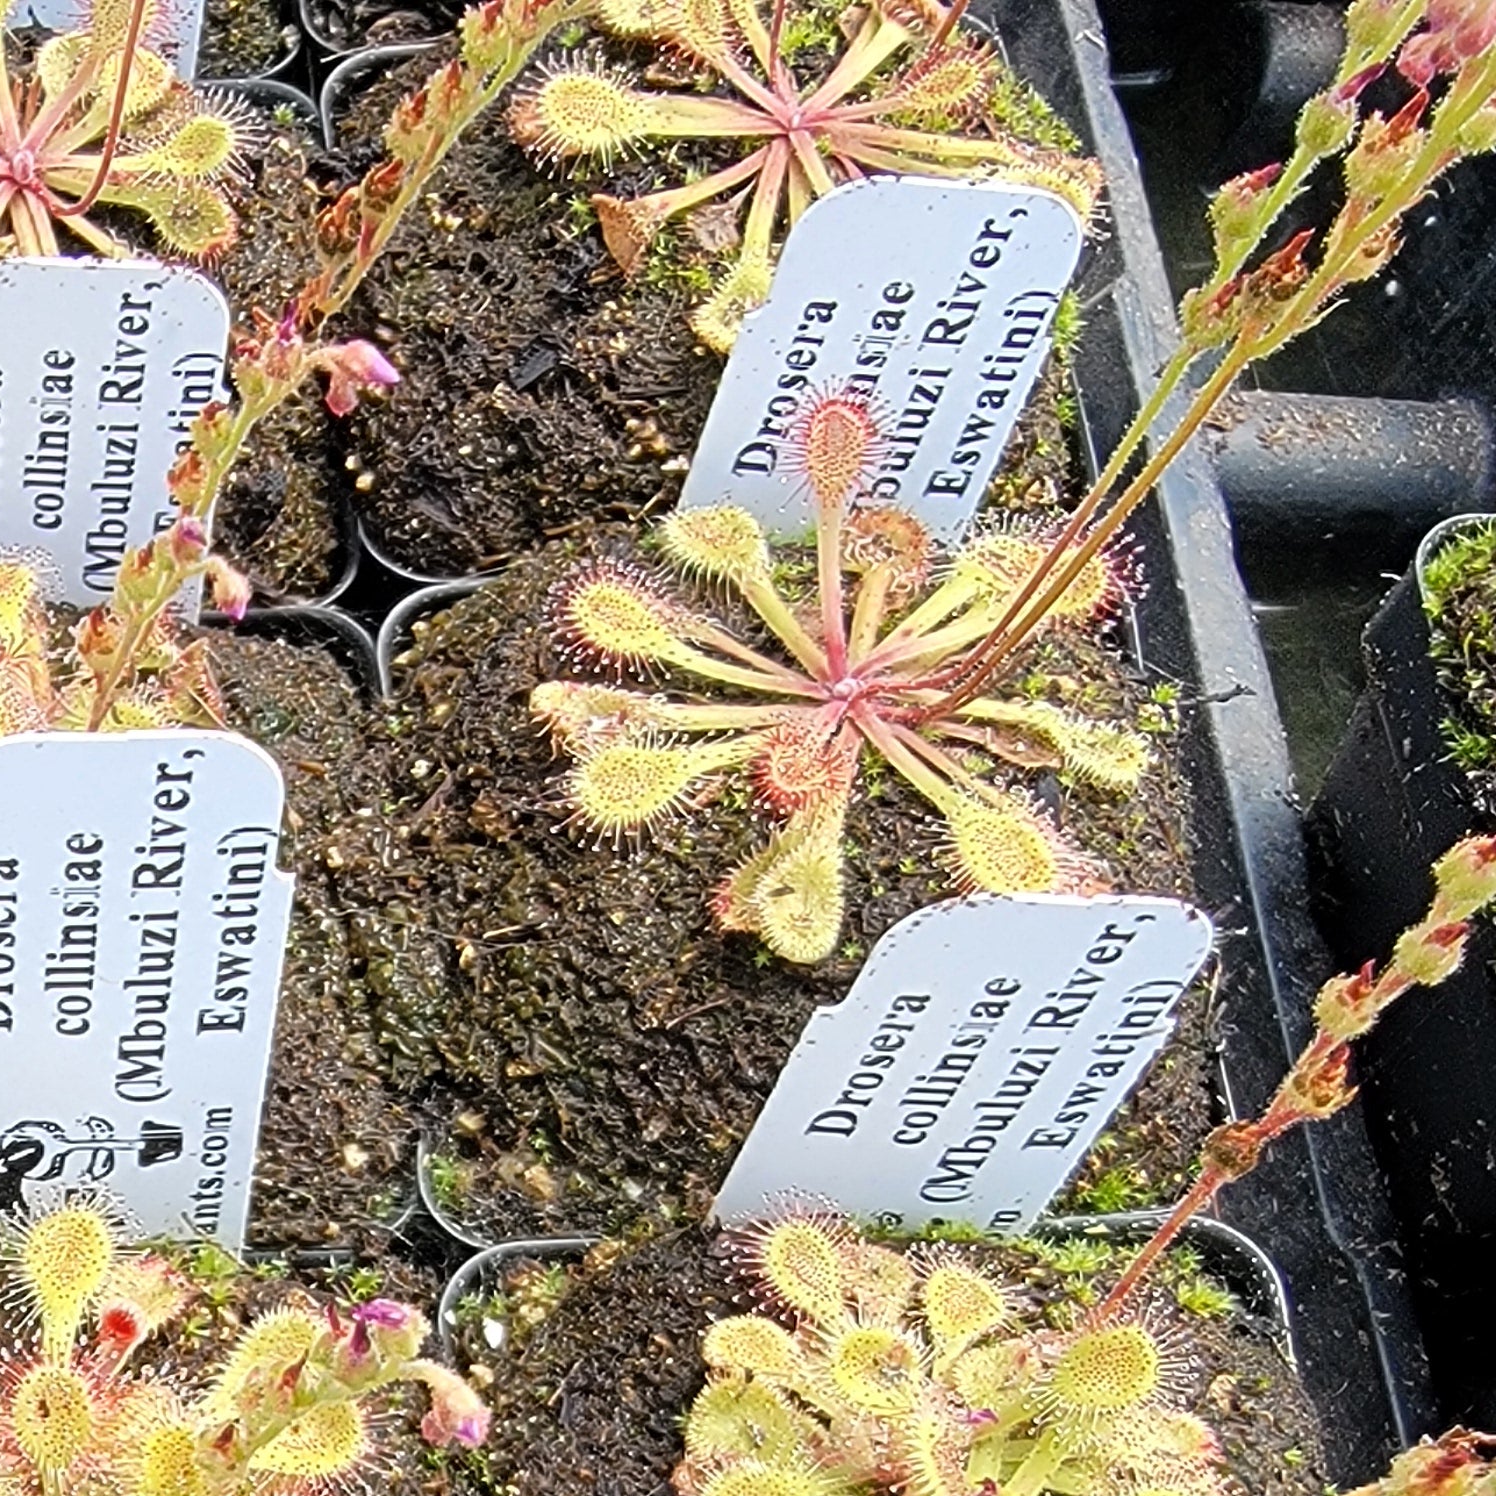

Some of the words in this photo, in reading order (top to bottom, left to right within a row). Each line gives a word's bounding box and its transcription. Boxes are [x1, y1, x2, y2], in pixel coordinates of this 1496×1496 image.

[98, 281, 163, 405] River,
[920, 208, 1029, 352] River,
[731, 300, 838, 477] Drosera
[923, 290, 1060, 499] Eswatini)
[82, 423, 140, 592] (Mbuluzi
[131, 749, 205, 895] River,
[45, 833, 104, 1035] collinsiae
[114, 910, 180, 1102] (Mbuluzi
[196, 827, 278, 1035] Eswatini)
[804, 992, 931, 1138] Drosera
[919, 1046, 1061, 1203] (Mbuluzi
[1025, 913, 1157, 1032] River,
[1022, 979, 1184, 1152] Eswatini)
[189, 1107, 233, 1235] ants.com
